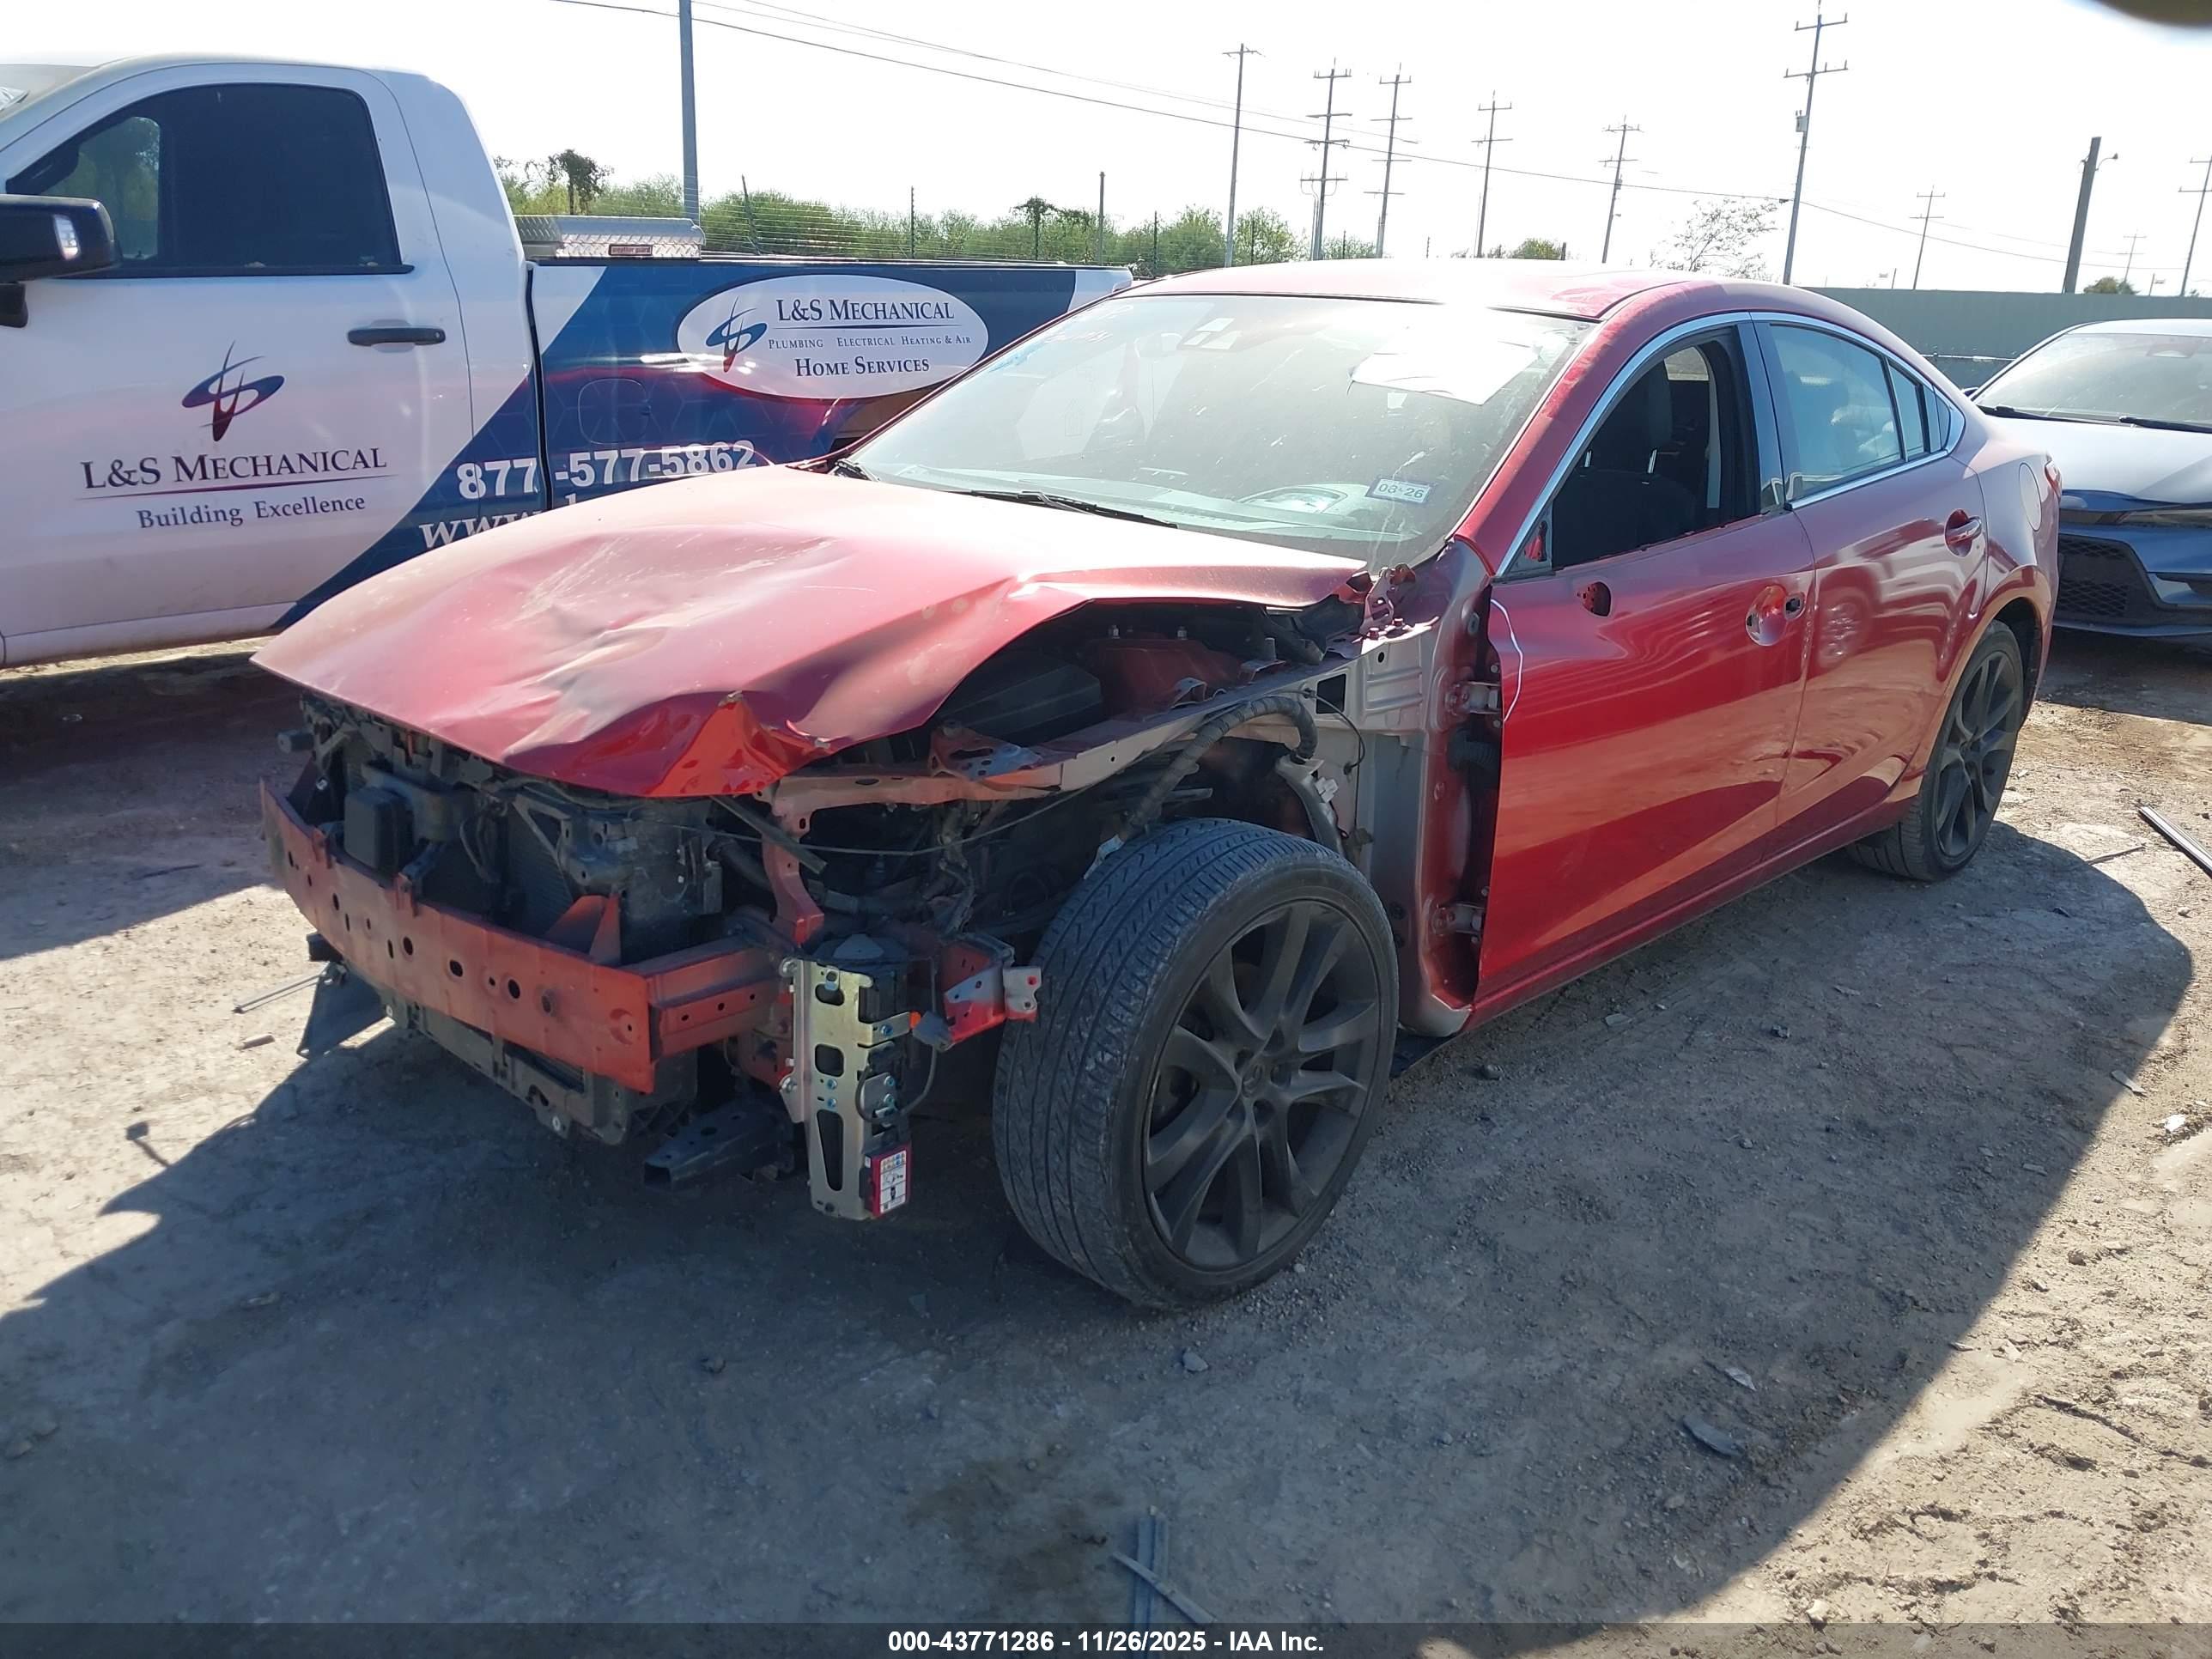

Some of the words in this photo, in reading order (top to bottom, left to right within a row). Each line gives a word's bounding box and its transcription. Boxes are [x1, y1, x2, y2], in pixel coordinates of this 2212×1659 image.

[776, 299, 823, 321] L&S
[828, 299, 955, 321] MECHANICAL
[769, 339, 823, 349] PLUMBING
[836, 337, 896, 348] ELECTRICAL
[901, 336, 942, 345] HEATING
[945, 335, 952, 344] &
[955, 335, 971, 344] AIR
[794, 357, 850, 377] HOME
[854, 356, 930, 376] SERVICES
[81, 457, 161, 489] L&S
[171, 447, 387, 483] MECHANICAL
[136, 505, 244, 527] Building
[253, 495, 366, 520] Excellence
